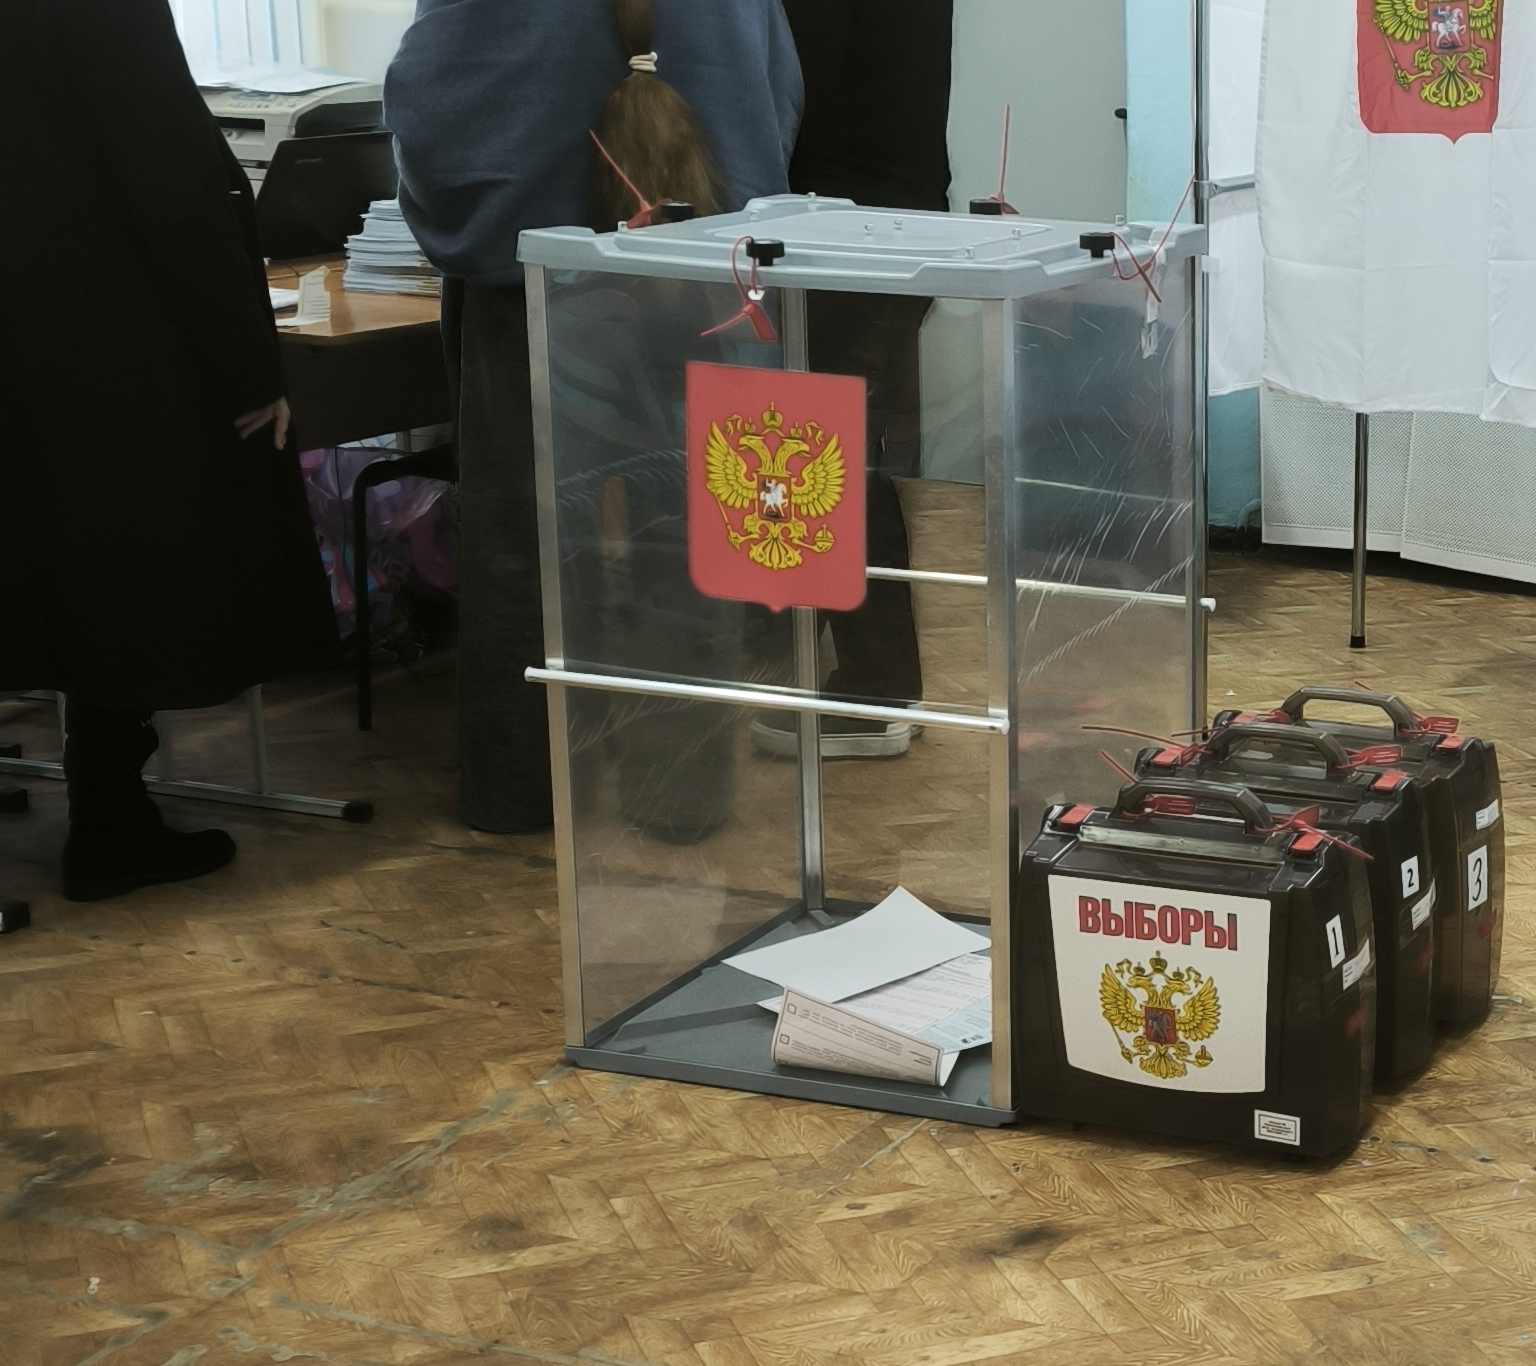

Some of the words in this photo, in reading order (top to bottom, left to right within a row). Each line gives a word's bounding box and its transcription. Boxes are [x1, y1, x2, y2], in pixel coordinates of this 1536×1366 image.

[1407, 868, 1415, 888] 2
[1472, 857, 1482, 902] 3
[1078, 895, 1238, 952] ВЫБОРЫ
[1331, 925, 1340, 957] 1
